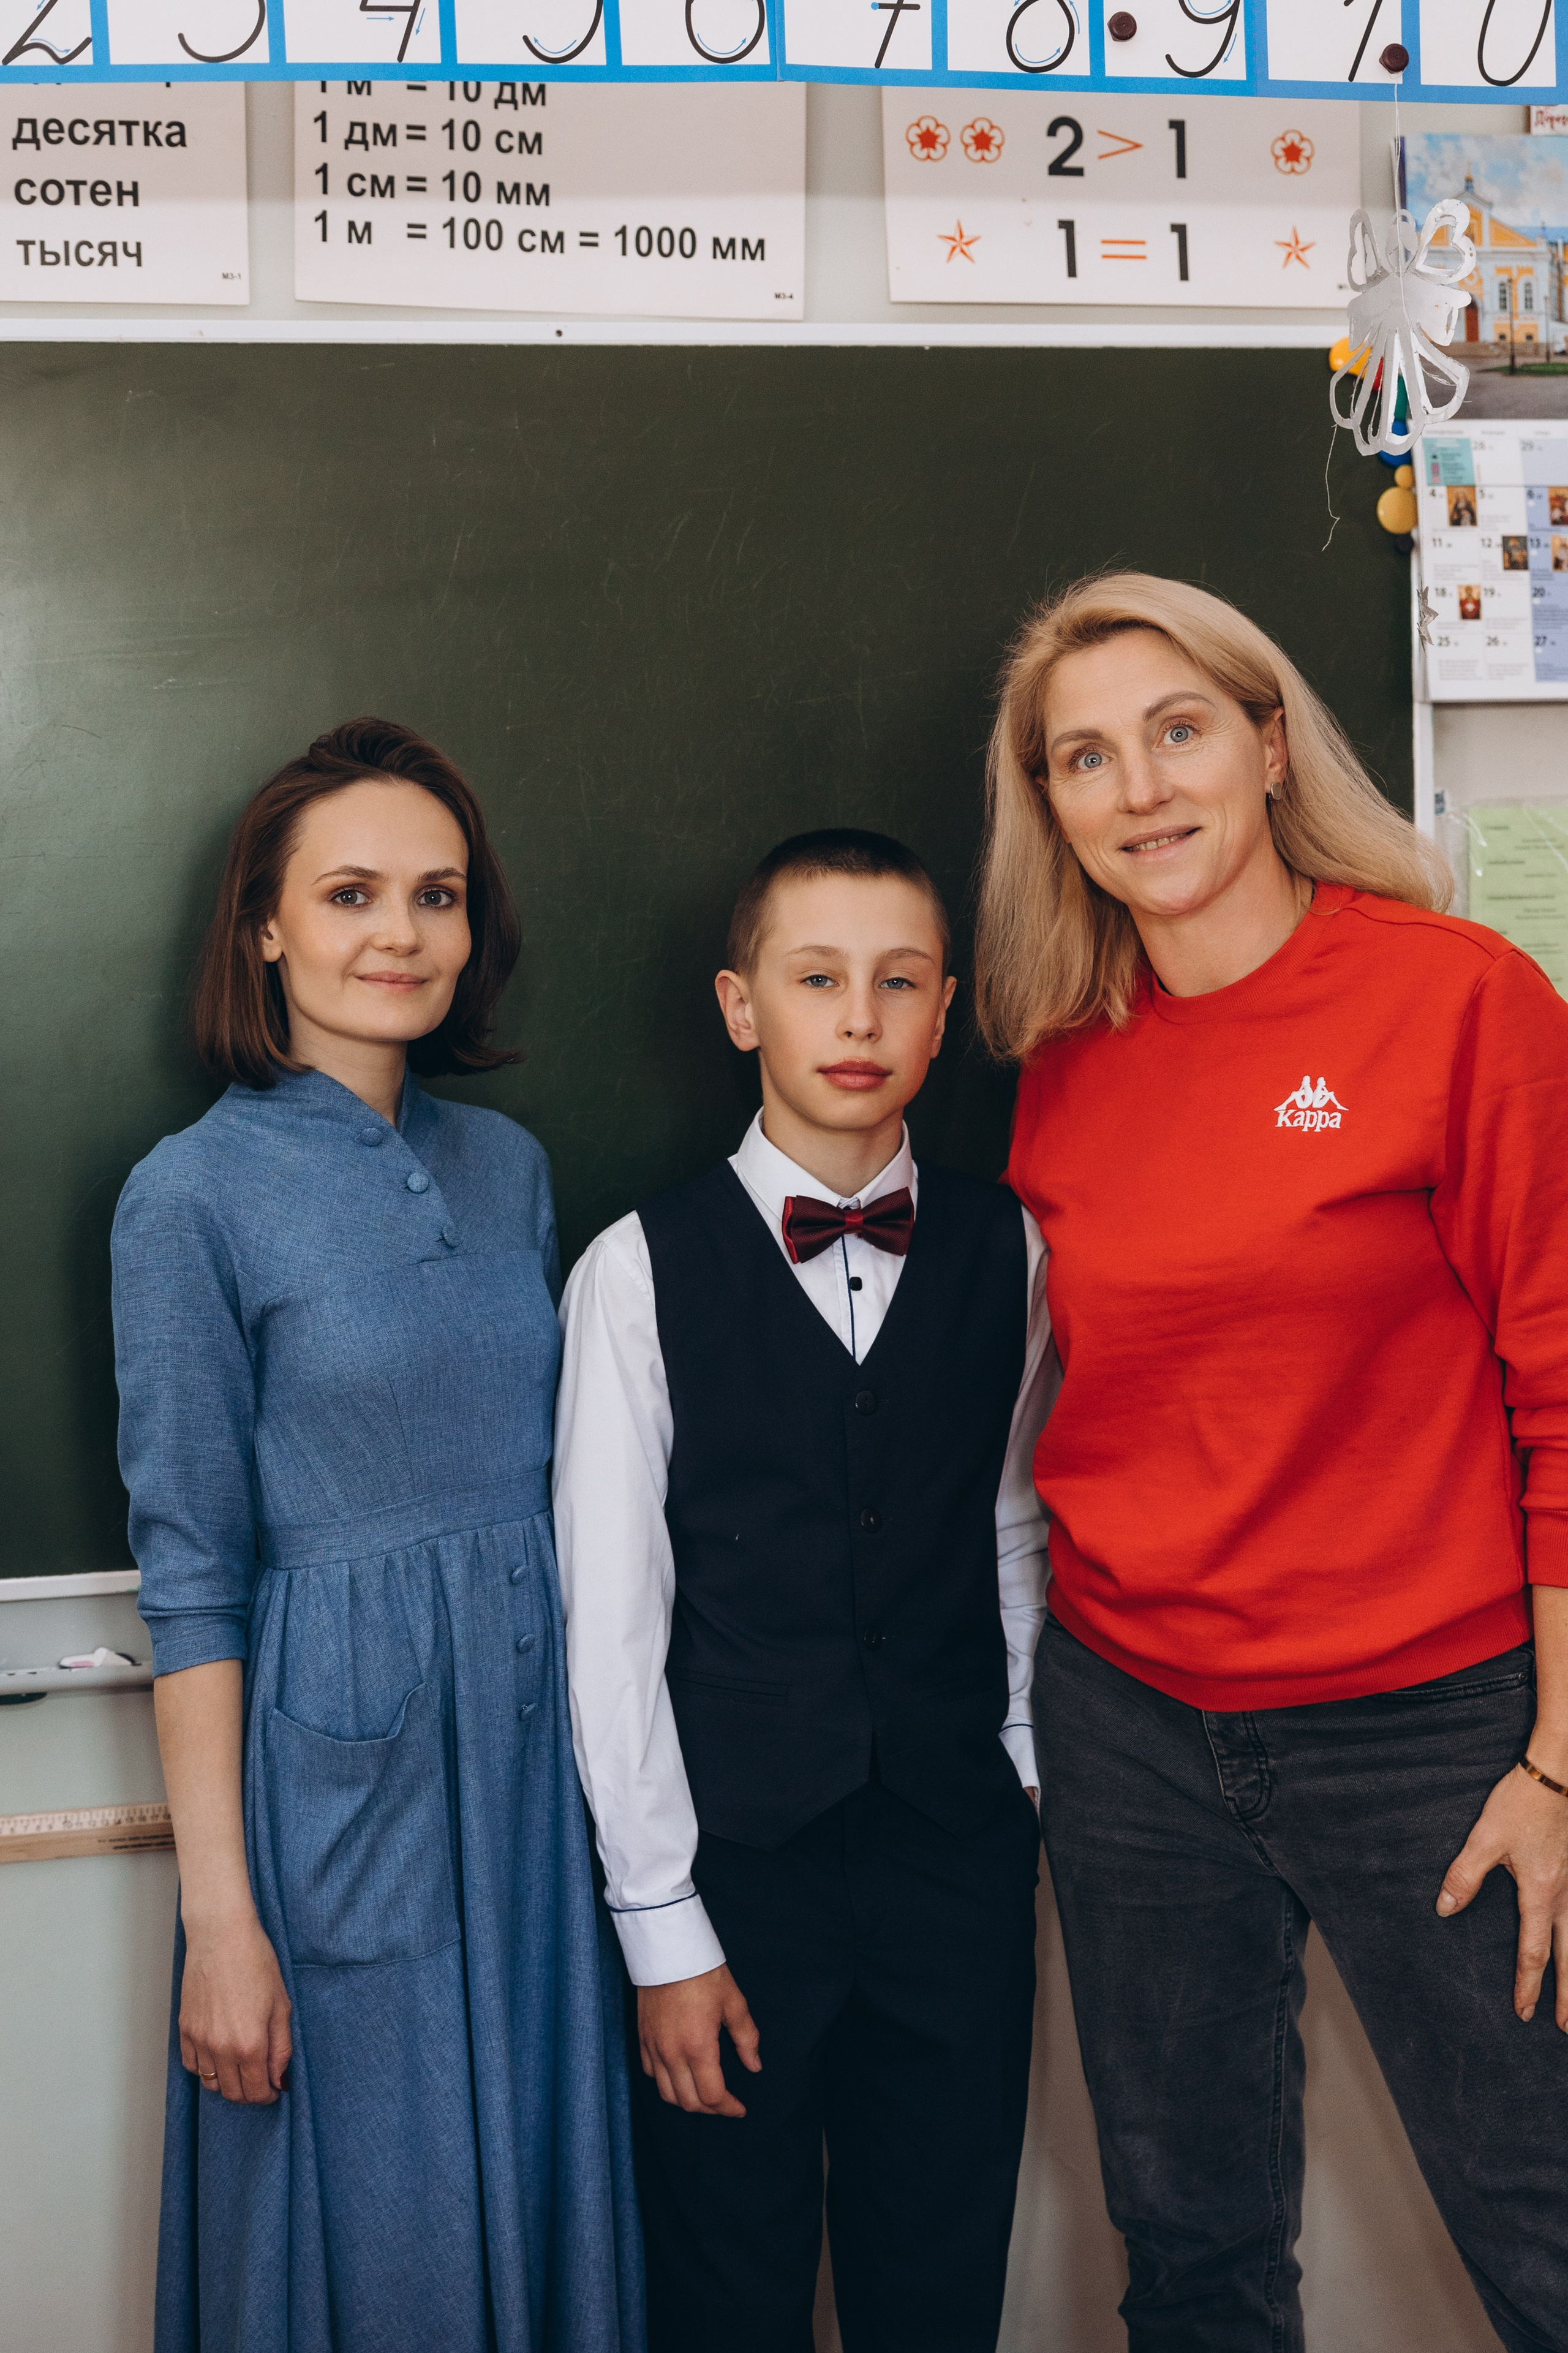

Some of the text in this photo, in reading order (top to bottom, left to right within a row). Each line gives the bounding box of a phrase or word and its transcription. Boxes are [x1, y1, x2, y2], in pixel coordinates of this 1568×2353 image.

[1165, 0, 1240, 78] 9
[494, 81, 546, 111] дм
[12, 117, 187, 151] десятка
[344, 121, 398, 152] дм
[441, 118, 481, 153] 10
[494, 130, 543, 156] см
[1046, 115, 1085, 178] 2
[1167, 119, 1187, 179] 1
[13, 178, 140, 208] сотен
[346, 172, 396, 199] см
[442, 169, 482, 204] 10
[496, 180, 551, 207] мм
[15, 239, 143, 268] тысяч
[314, 210, 328, 243] 1
[347, 219, 372, 245] м
[442, 216, 504, 252] 100
[517, 229, 565, 254] см
[614, 224, 698, 260] 1000
[712, 236, 766, 262] мм
[1057, 219, 1078, 279] 1
[1169, 223, 1189, 282] 1
[1275, 1109, 1341, 1132] Kappa
